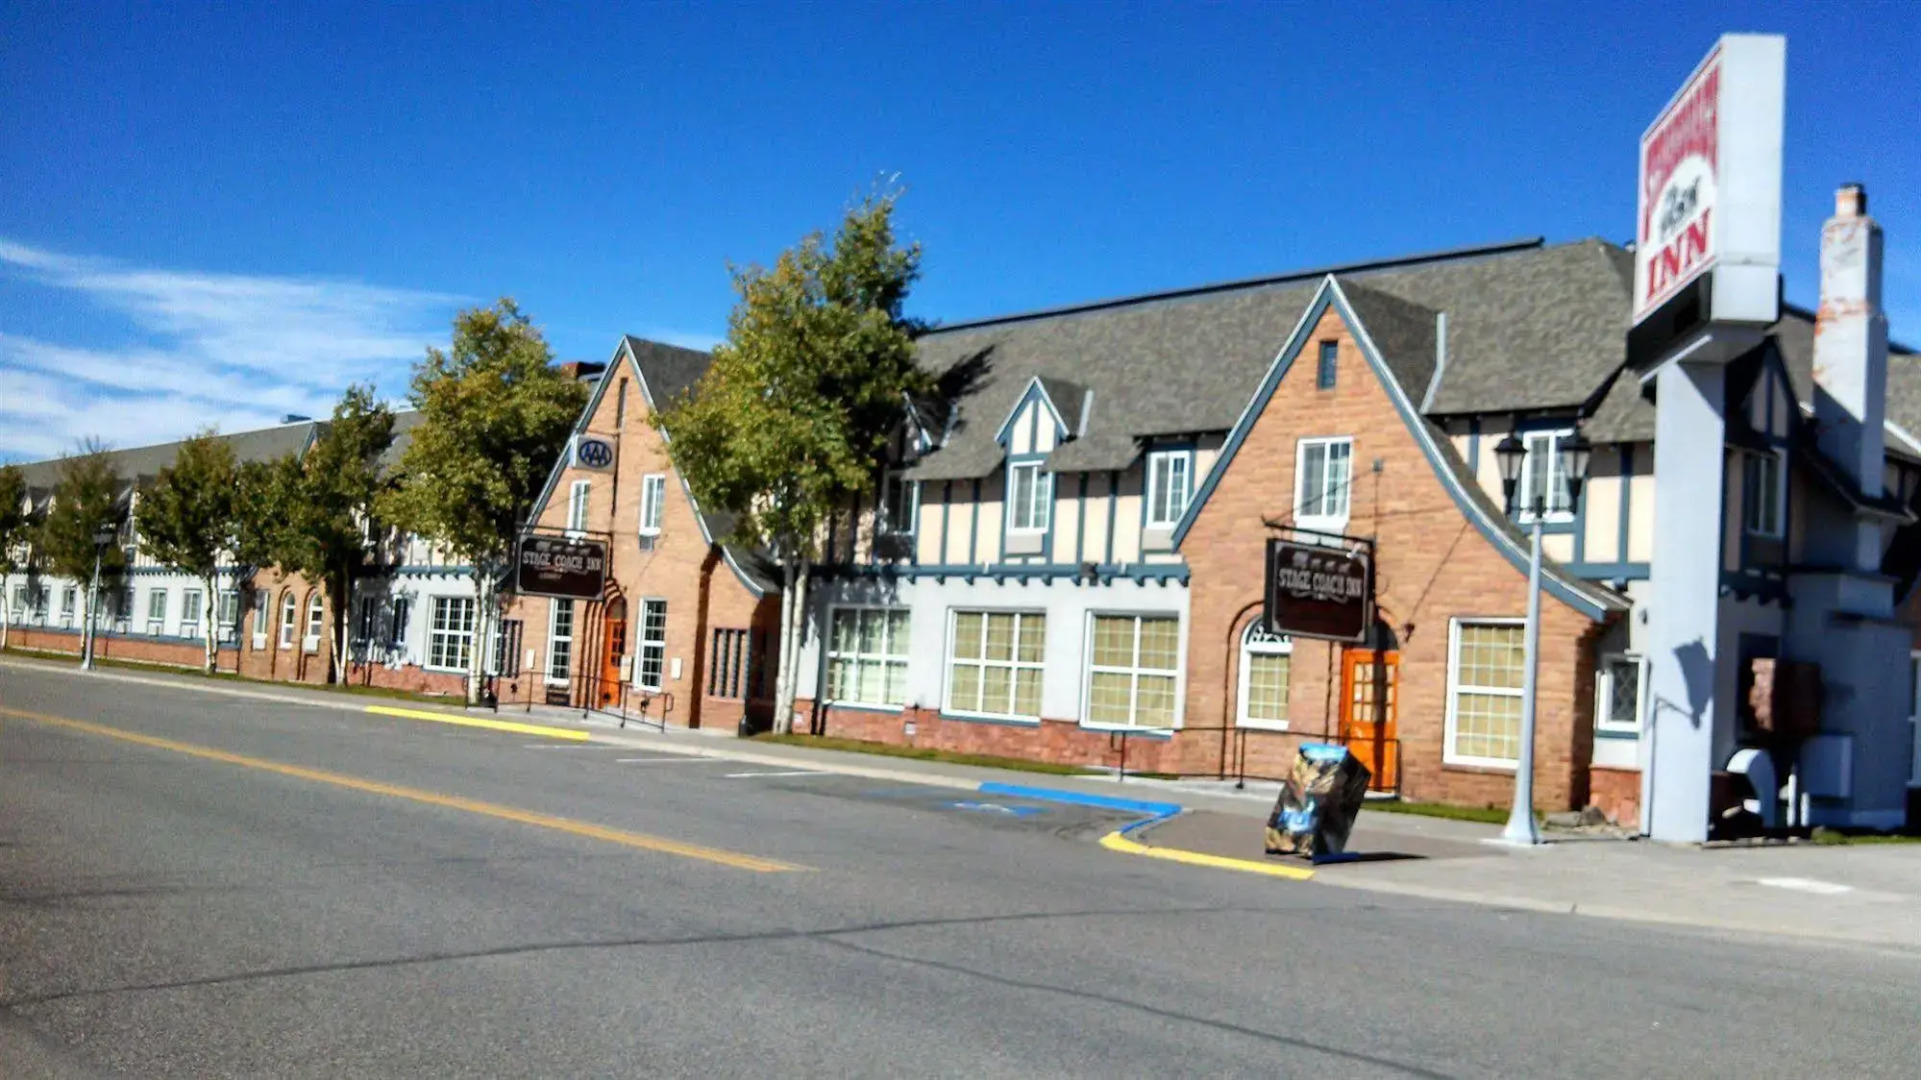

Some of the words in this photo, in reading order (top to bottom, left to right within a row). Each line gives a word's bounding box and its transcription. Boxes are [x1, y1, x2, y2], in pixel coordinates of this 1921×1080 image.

[1647, 206, 1710, 300] INN
[582, 443, 608, 465] AAA
[523, 551, 551, 565] STAGE
[554, 554, 583, 569] COACH
[586, 556, 603, 571] INN
[1279, 568, 1311, 589] STAGE
[1313, 572, 1345, 594] COACH
[1346, 577, 1362, 597] INN
